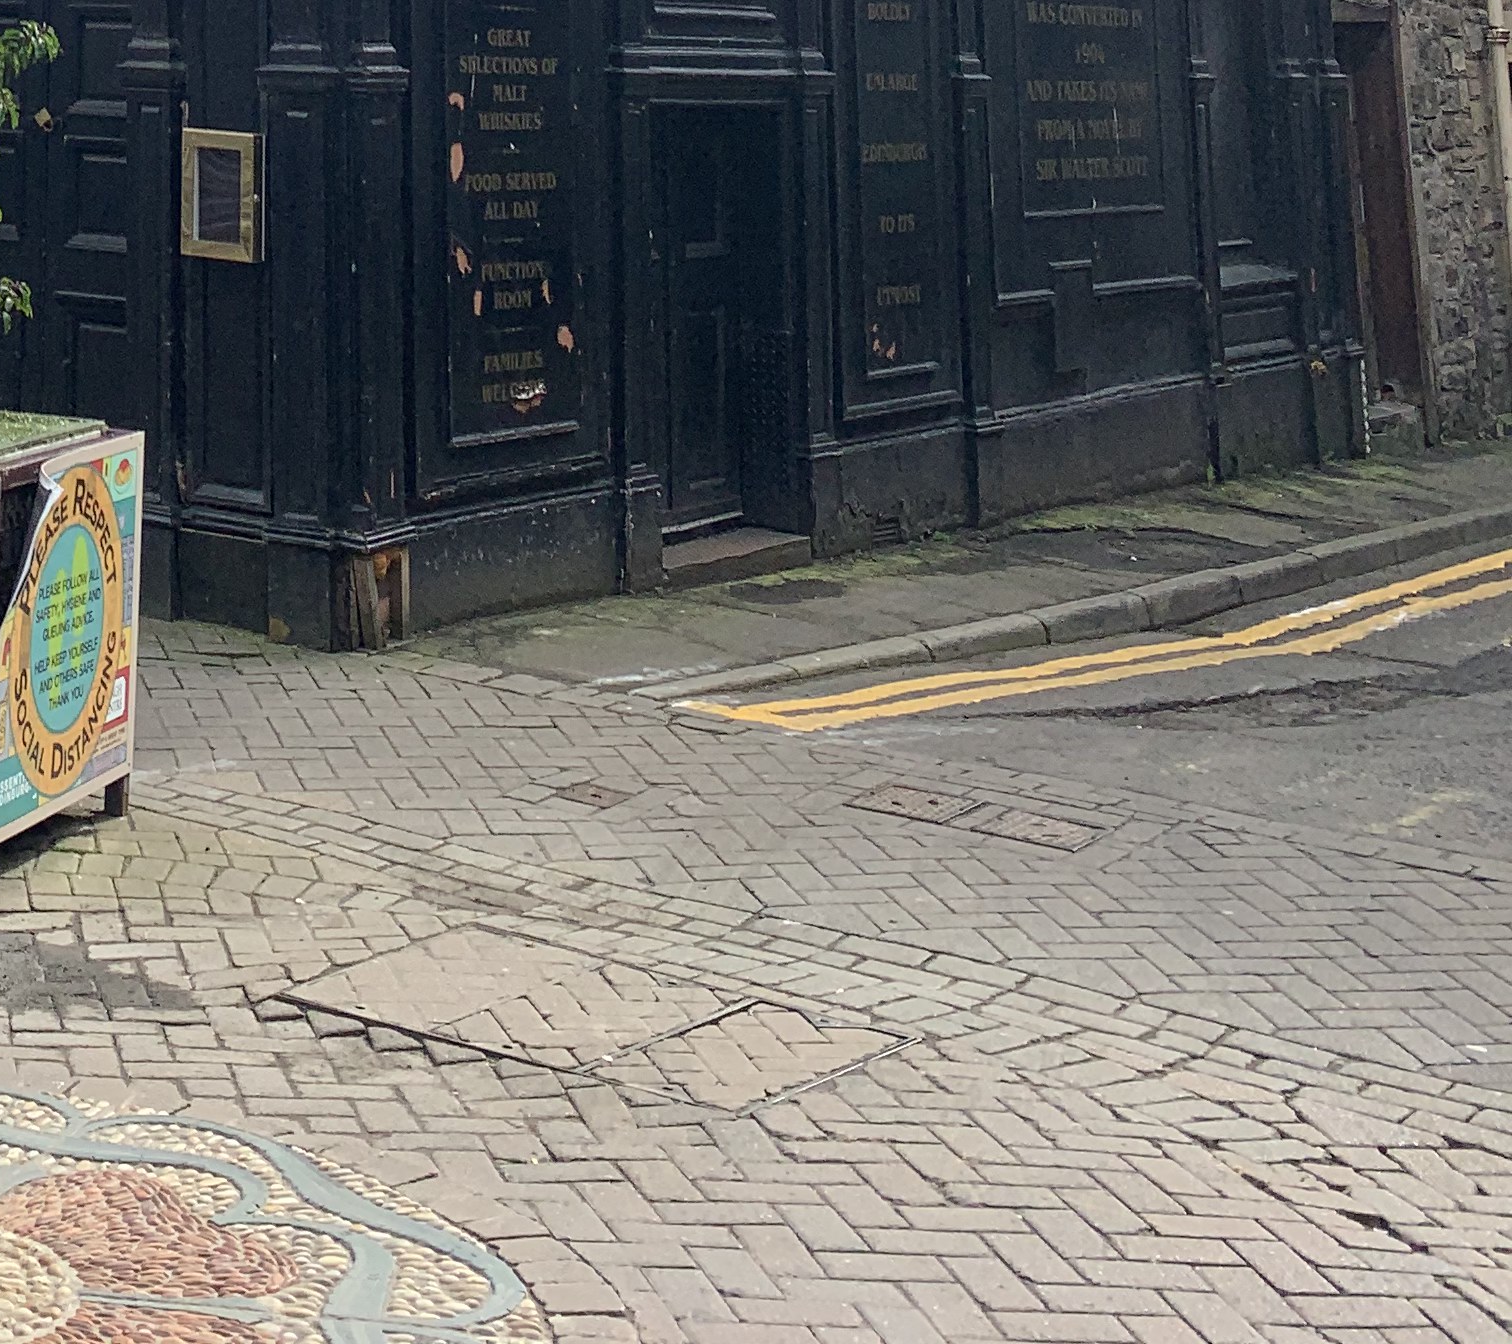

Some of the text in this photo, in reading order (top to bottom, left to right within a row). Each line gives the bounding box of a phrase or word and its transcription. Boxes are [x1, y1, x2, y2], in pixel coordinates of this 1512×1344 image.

[487, 28, 531, 48] GREAT
[459, 54, 558, 76] SELECTIONS OF
[493, 83, 527, 102] MALT
[478, 111, 543, 131] WHISKIES
[465, 171, 557, 192] FOOD SERVED
[484, 200, 539, 221] ALL DAY
[481, 261, 547, 282] FUNCTION
[493, 290, 532, 309] ROOM
[484, 351, 544, 372] FAMILIES
[19, 495, 68, 616] PLEASE
[72, 478, 117, 584] RESPECT
[38, 569, 100, 601] PLEASE FOLLOW ALL
[35, 603, 61, 624] SAFETY,
[88, 587, 101, 602] AND
[34, 636, 98, 674] HELP KEEP YOURSELF
[39, 658, 94, 695] AND OTHERS SAFE
[14, 631, 117, 779] SOCIAL DISTANCING
[48, 686, 85, 711] THANK YOU
